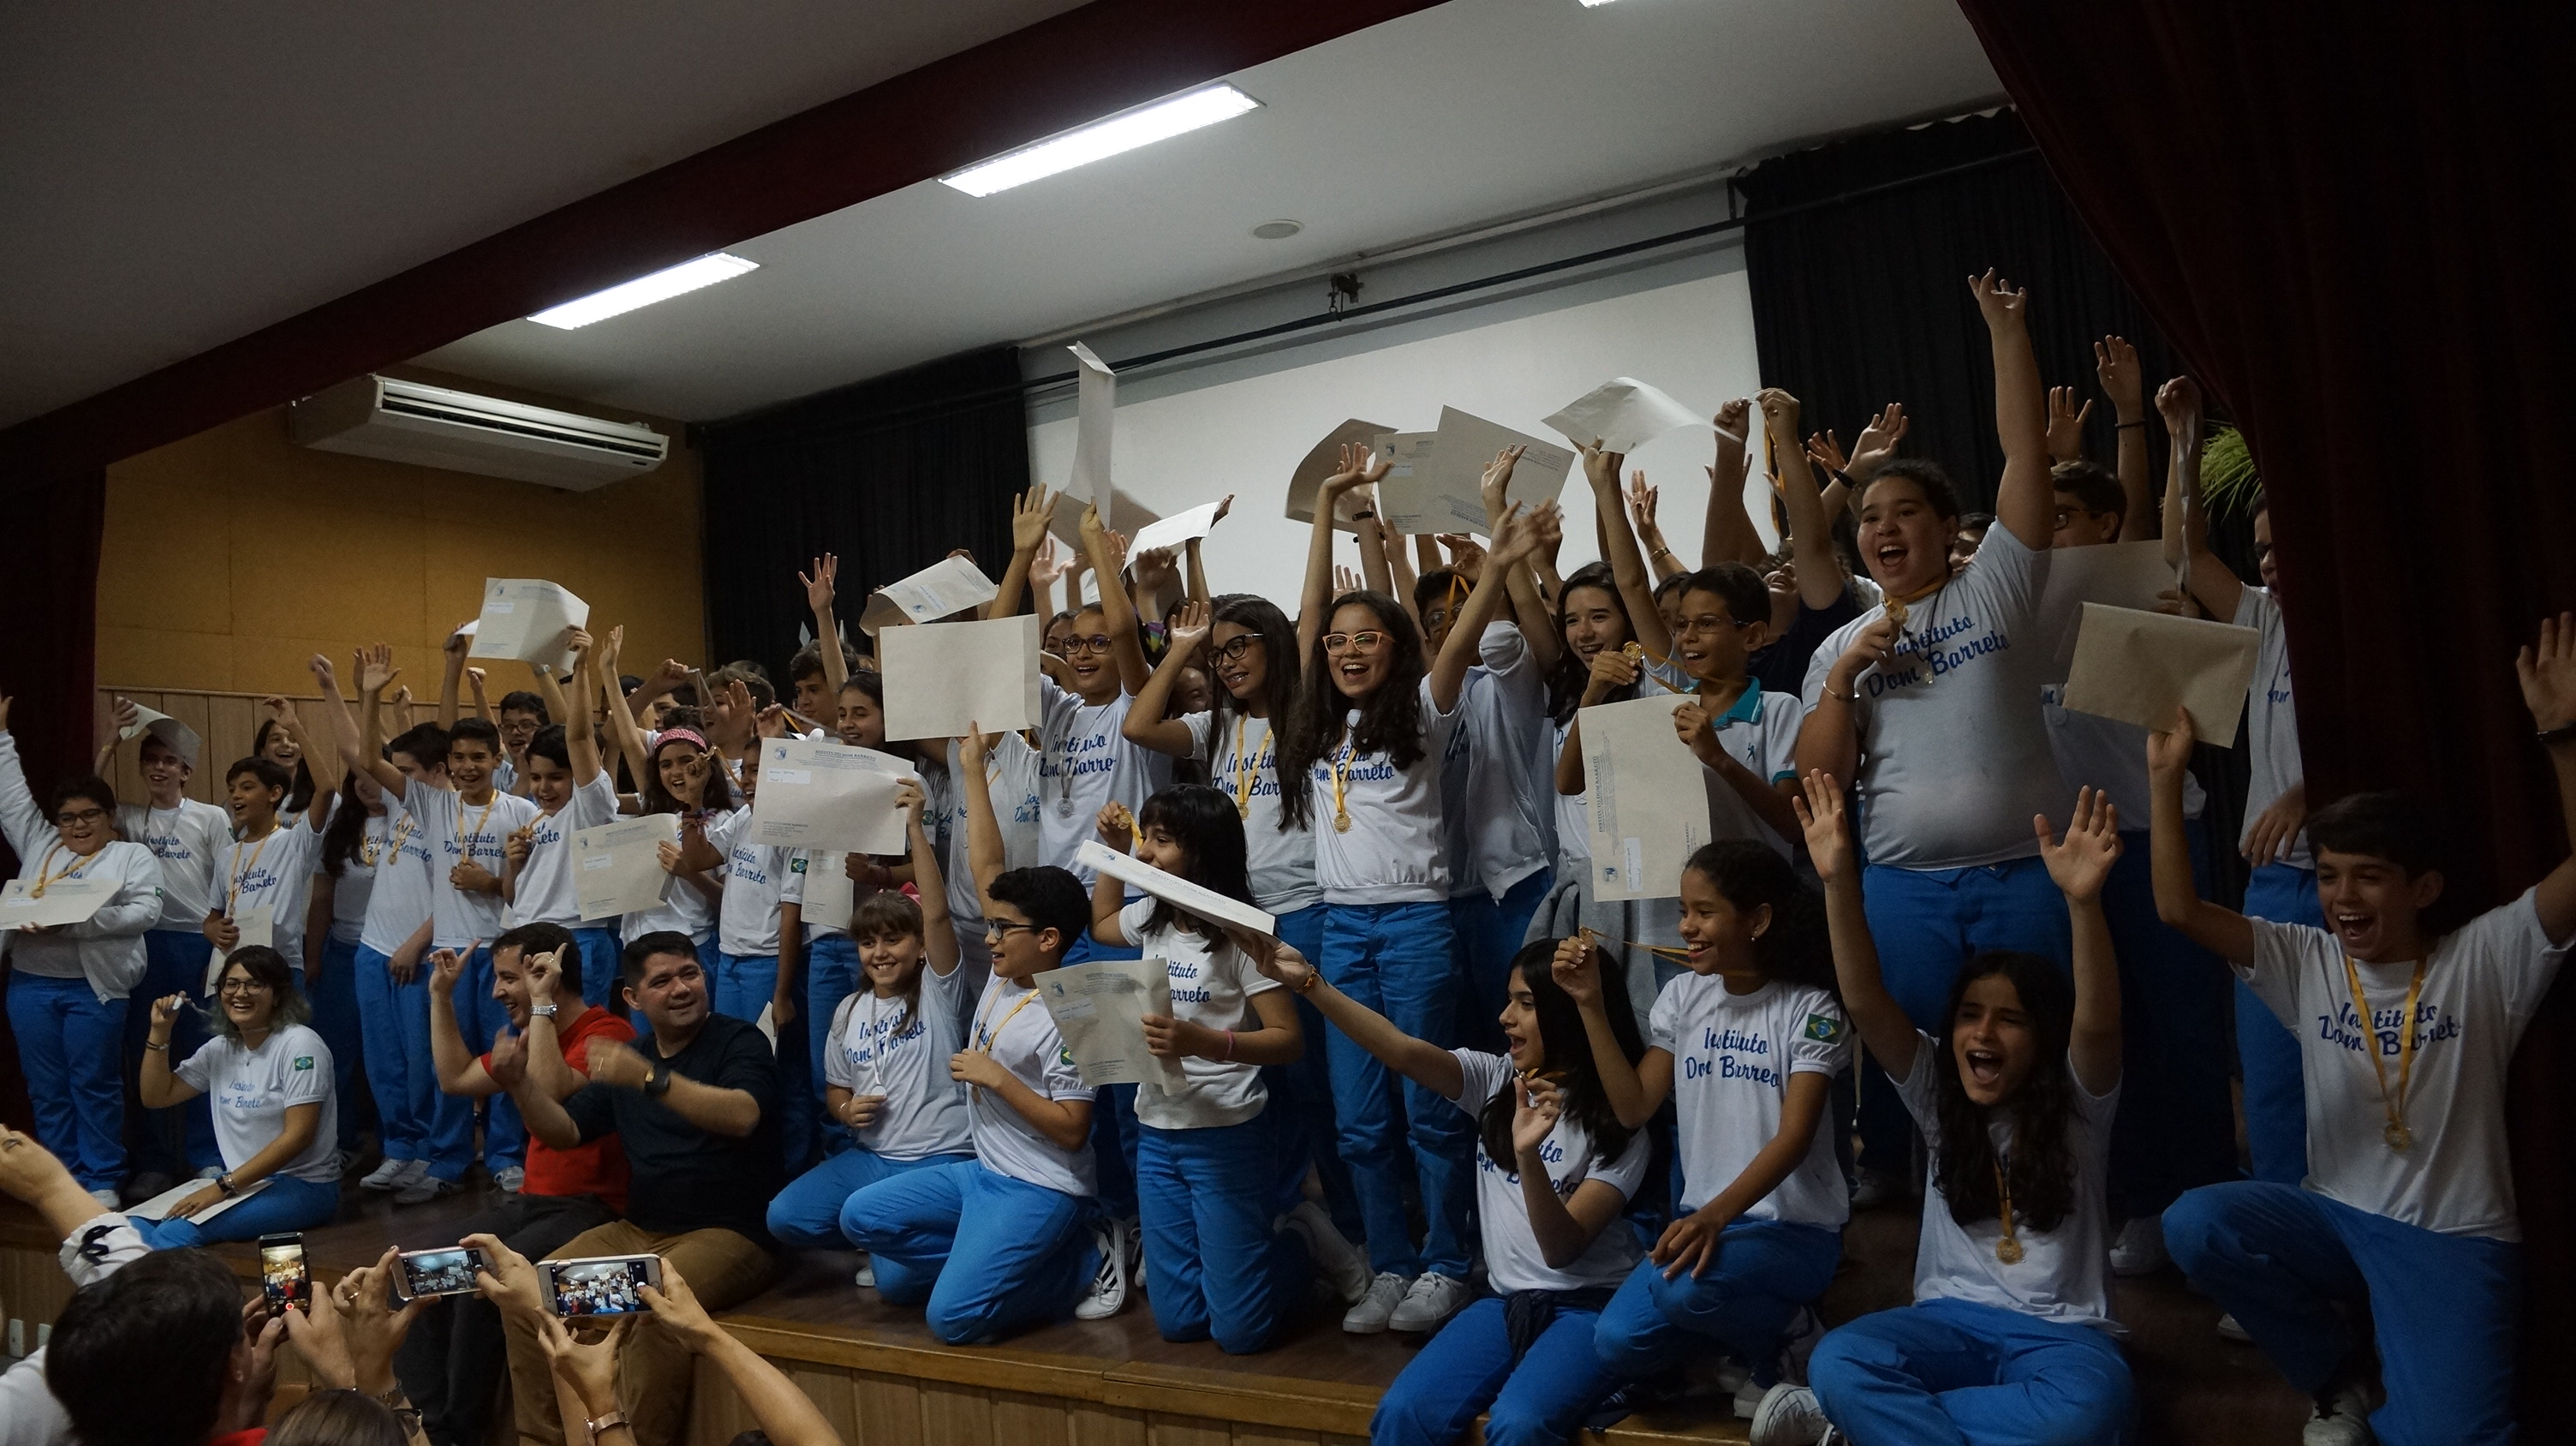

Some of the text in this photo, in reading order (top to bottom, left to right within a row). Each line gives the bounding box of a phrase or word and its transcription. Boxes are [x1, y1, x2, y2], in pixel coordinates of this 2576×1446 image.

[1896, 615, 1976, 657] nstituto
[1865, 630, 2010, 698] Dom Barreto
[1226, 751, 1276, 773] Insttu
[1168, 959, 1198, 979] tituto
[1170, 986, 1211, 1003] arreto
[1704, 1027, 1768, 1055] Instituto
